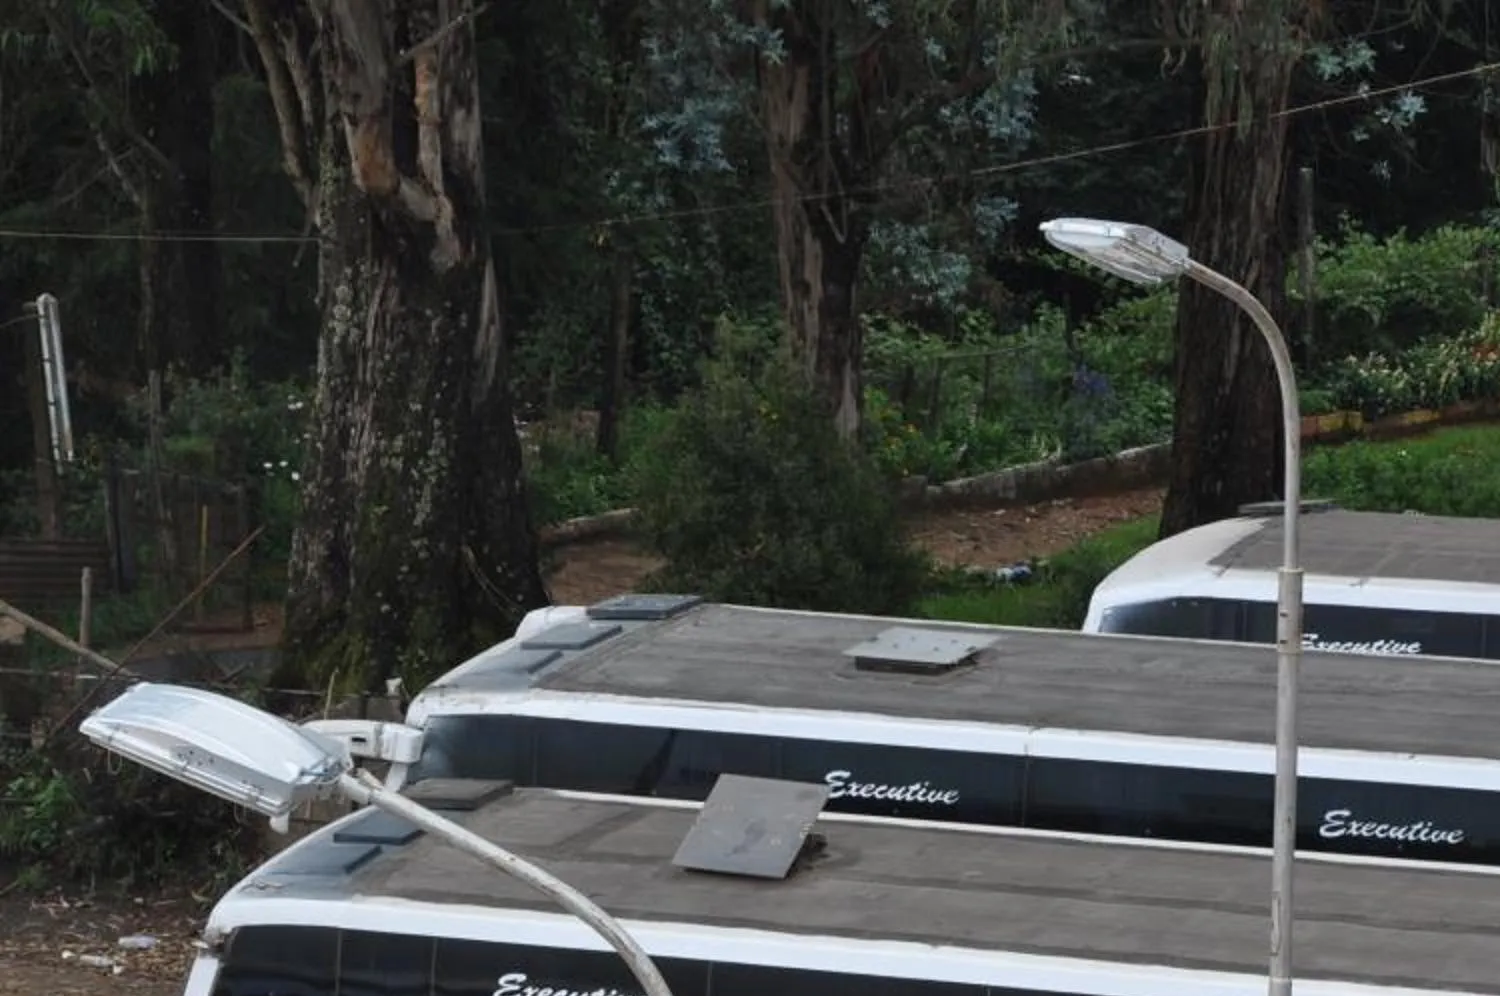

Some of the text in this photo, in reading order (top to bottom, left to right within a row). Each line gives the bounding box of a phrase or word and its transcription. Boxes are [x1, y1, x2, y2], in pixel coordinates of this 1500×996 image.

[1300, 632, 1421, 653] Executive
[823, 769, 959, 806] Executive
[1319, 809, 1464, 844] Executive
